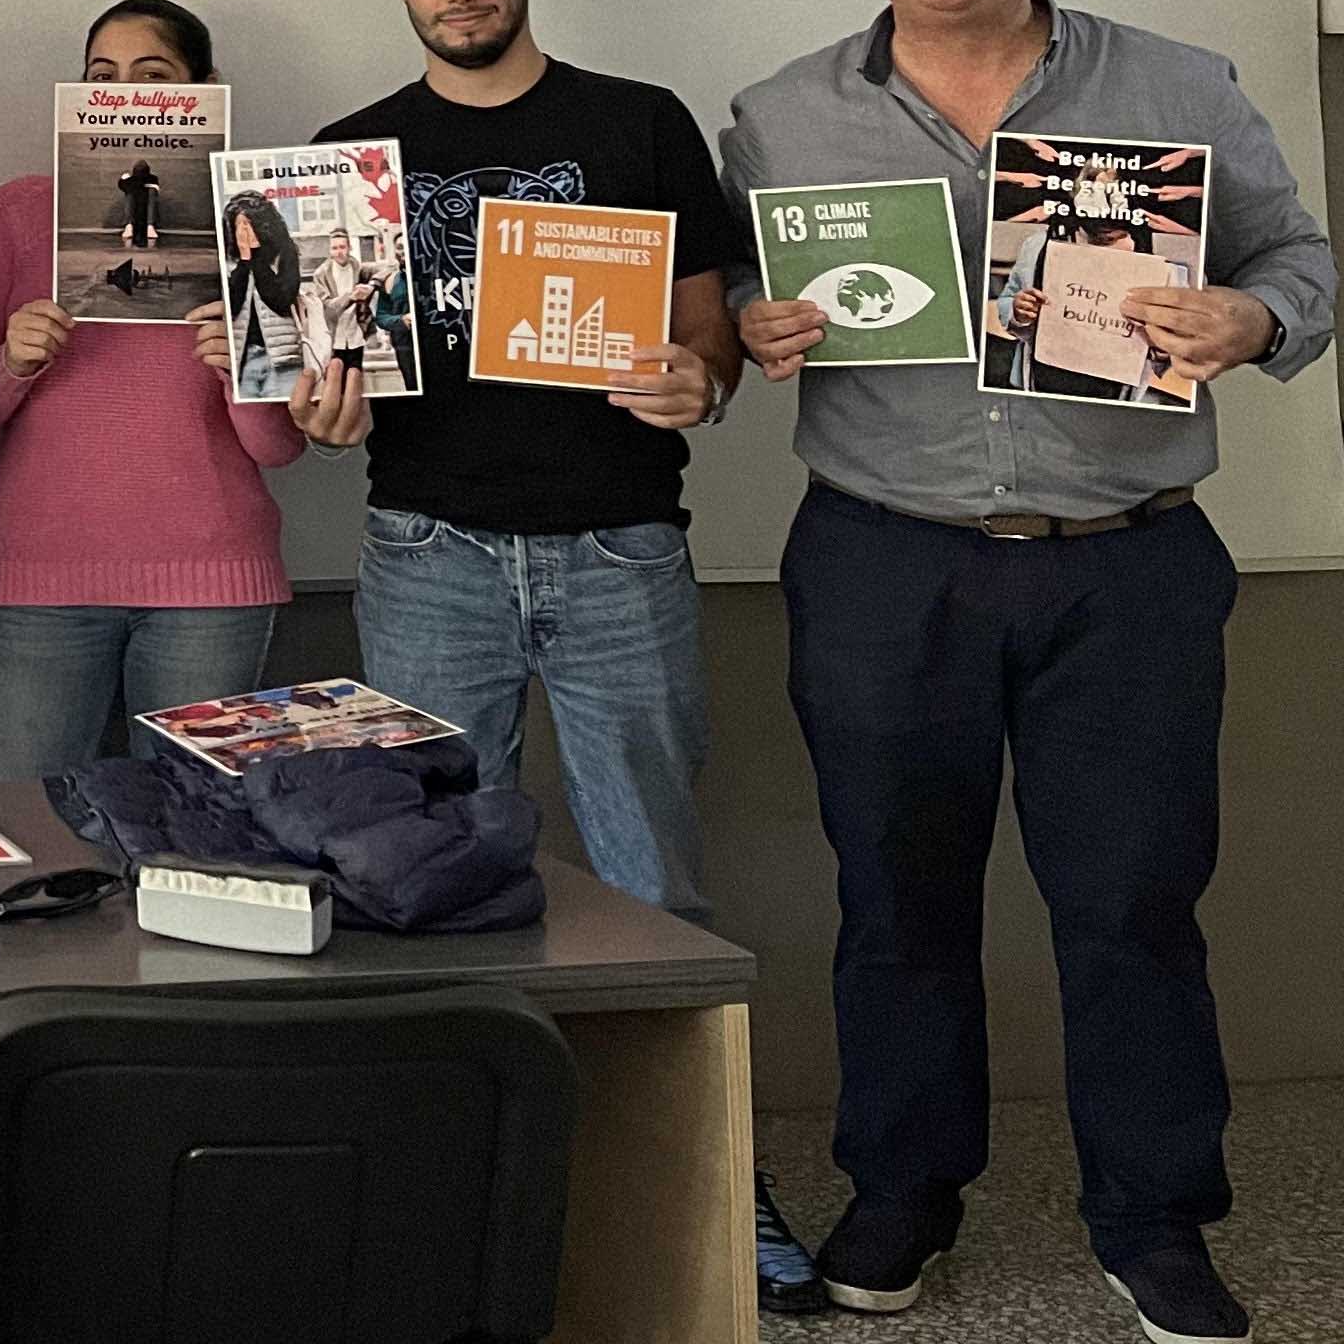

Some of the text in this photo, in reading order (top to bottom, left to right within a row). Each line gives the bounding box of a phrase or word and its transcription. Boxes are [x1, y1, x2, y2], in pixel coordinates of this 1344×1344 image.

[88, 90, 200, 113] Stop bullying
[77, 112, 208, 127] Your words are
[89, 134, 194, 151] your choice.
[1059, 151, 1141, 170] Be kind
[264, 162, 351, 179] BULLYING
[264, 185, 326, 200] CRIME.
[1047, 175, 1073, 191] Be
[814, 201, 872, 221] CLIMATE
[1043, 200, 1070, 216] Be
[771, 205, 808, 242] 13
[817, 222, 868, 241] ACTION
[497, 218, 524, 256] 11
[534, 221, 662, 247] SUSTAINABLE CITIES
[533, 242, 651, 266] AND COMMUNITIES
[1065, 283, 1108, 303] Stop
[1063, 309, 1135, 337] bullying
